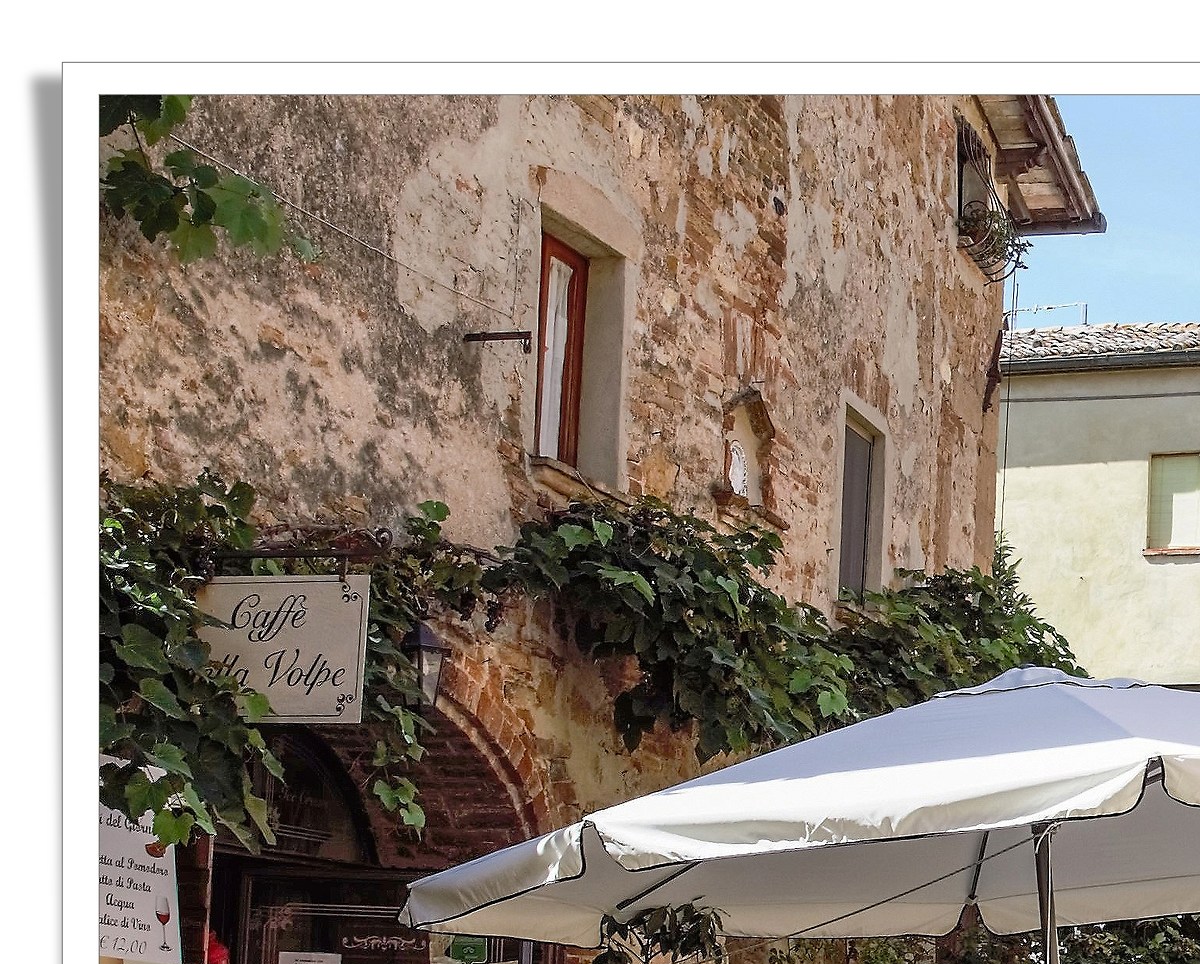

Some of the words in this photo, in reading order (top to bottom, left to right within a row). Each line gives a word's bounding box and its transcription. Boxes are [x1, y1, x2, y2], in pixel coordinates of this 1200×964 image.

[231, 594, 308, 642] Caffè
[264, 649, 346, 695] Volpe
[106, 813, 122, 828] del
[125, 818, 153, 835] Giorn
[115, 856, 125, 869] al
[127, 858, 169, 876] Pomodoro
[115, 876, 125, 888] di
[126, 877, 152, 893] Pasta
[105, 893, 135, 911] Acqua
[120, 916, 129, 928] di
[131, 917, 151, 931] Vino
